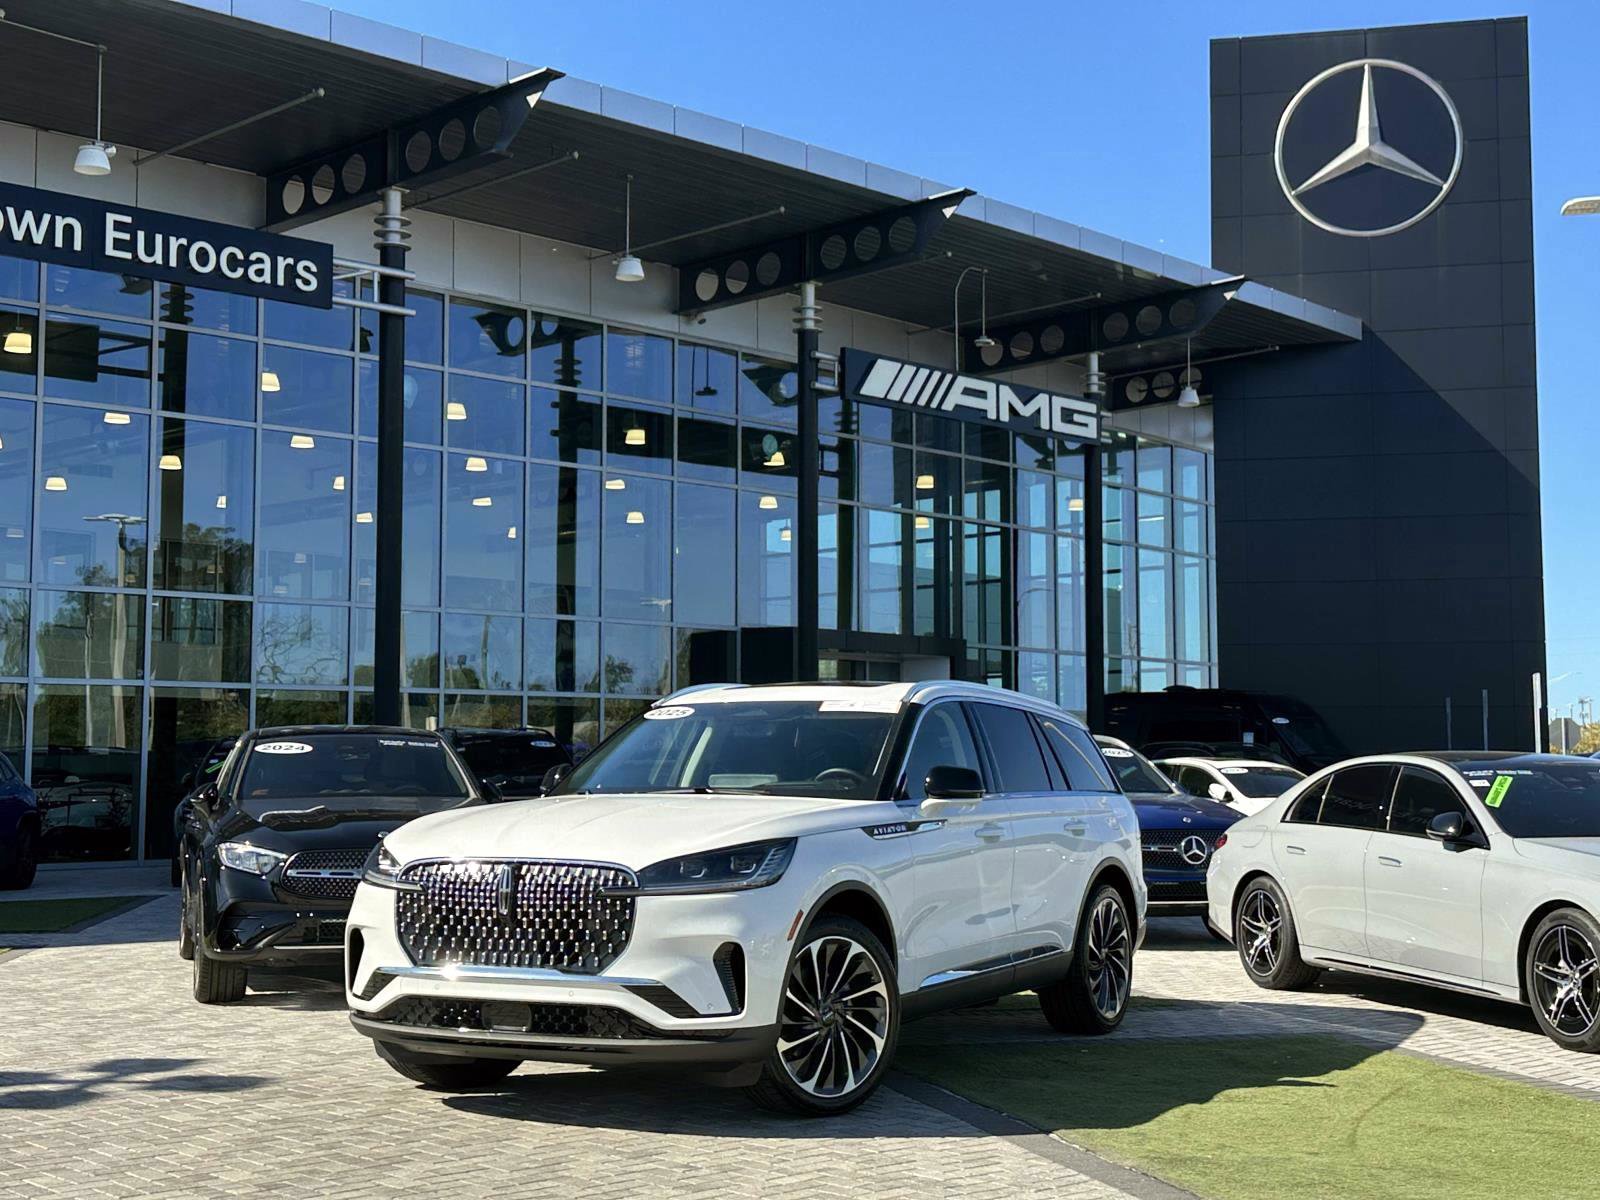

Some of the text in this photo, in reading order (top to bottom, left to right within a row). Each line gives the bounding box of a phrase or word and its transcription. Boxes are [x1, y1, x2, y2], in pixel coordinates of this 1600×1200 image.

[0, 206, 318, 292] wn Eurocars
[941, 375, 1098, 439] AMG
[649, 708, 692, 716] 2025
[873, 824, 907, 835] AVIATOR
